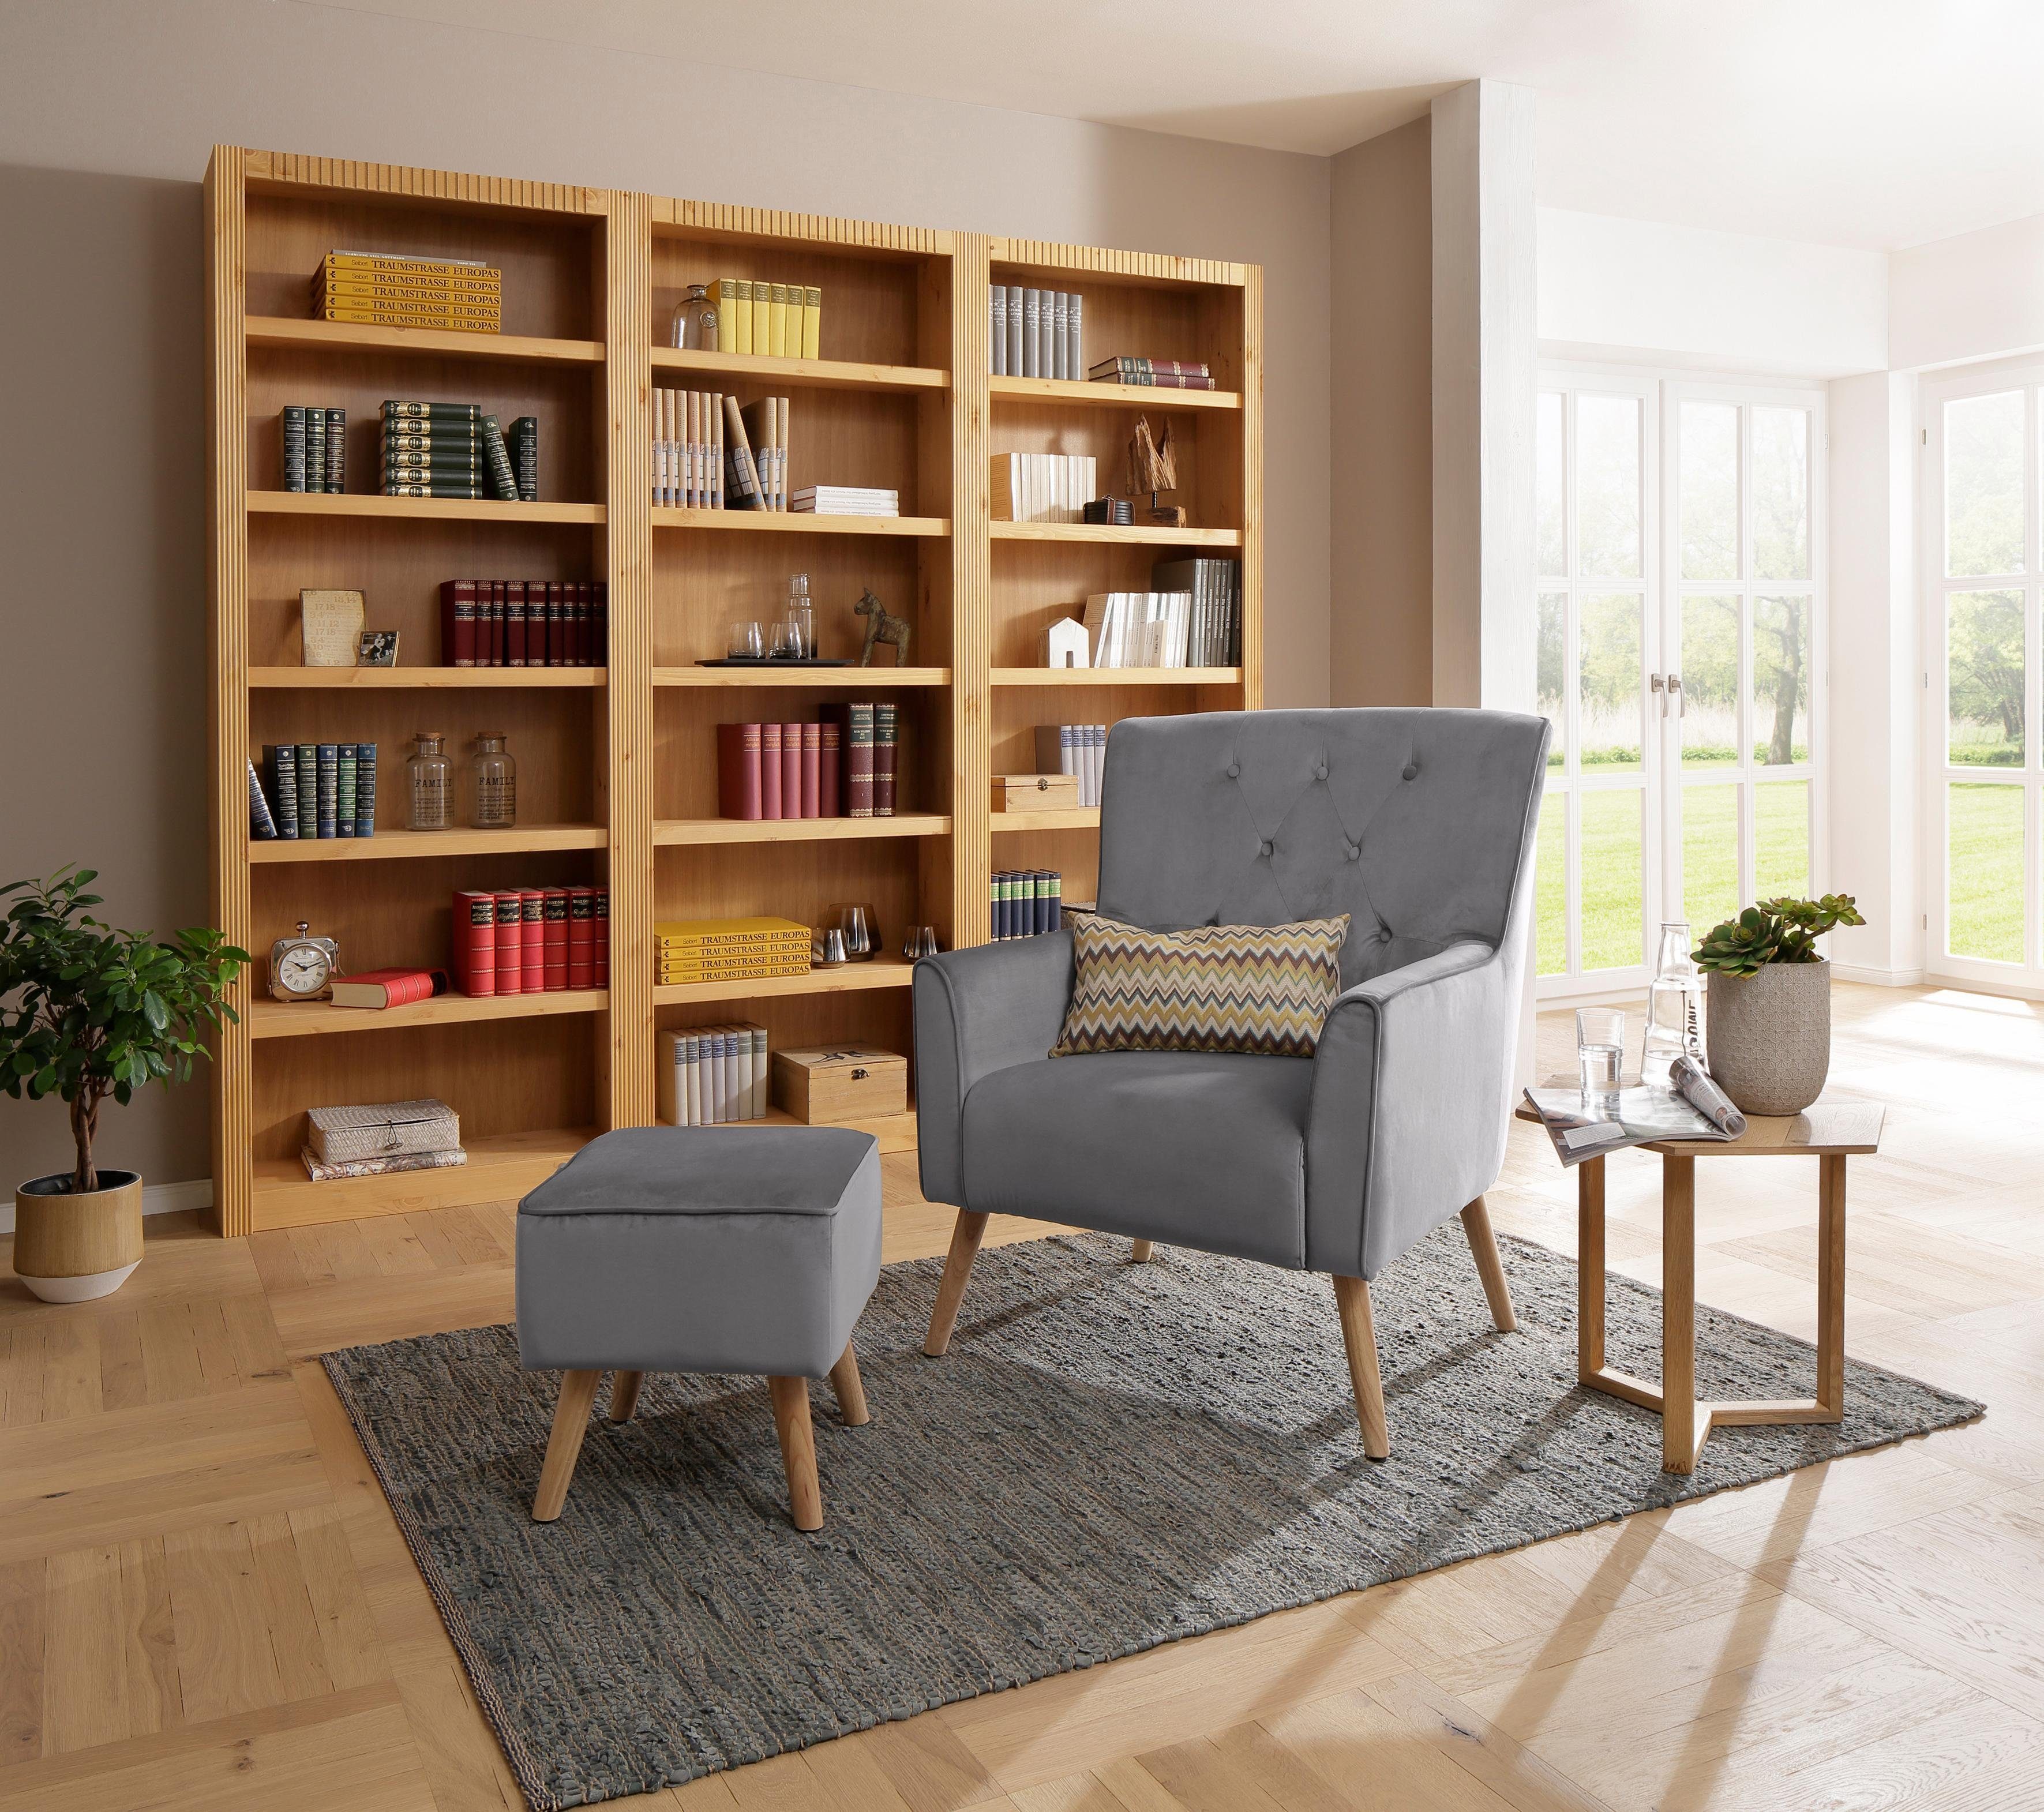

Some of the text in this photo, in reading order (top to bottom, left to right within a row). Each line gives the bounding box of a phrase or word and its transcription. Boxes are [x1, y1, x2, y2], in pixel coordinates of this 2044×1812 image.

[372, 260, 449, 274] TRAUMSTRASSE
[453, 267, 499, 278] EUROPAS
[372, 273, 449, 287] TRAUMSTRASSE
[453, 280, 499, 291] EUROPAS
[372, 287, 450, 301] TRAUMSTRASSE
[453, 294, 500, 305] EUROPAS
[372, 300, 449, 314] TRAUMSTRASSE
[453, 307, 498, 317] EUROPAS
[371, 314, 449, 327] TRAUMSTRASSE
[453, 320, 498, 330] EUROPAS
[415, 779, 452, 787] FAMILY
[700, 933, 767, 944] TRAUMSTRASSE
[771, 930, 809, 939] EUROPAS
[699, 945, 767, 956] TRAUMSTRASSE
[770, 942, 809, 951] EUROPAS
[700, 956, 767, 968] TRAUMSTRASSE
[770, 953, 809, 963] EUROPAS
[700, 968, 767, 980] TRAUMSTRASSE
[770, 965, 809, 975] EUROPAS
